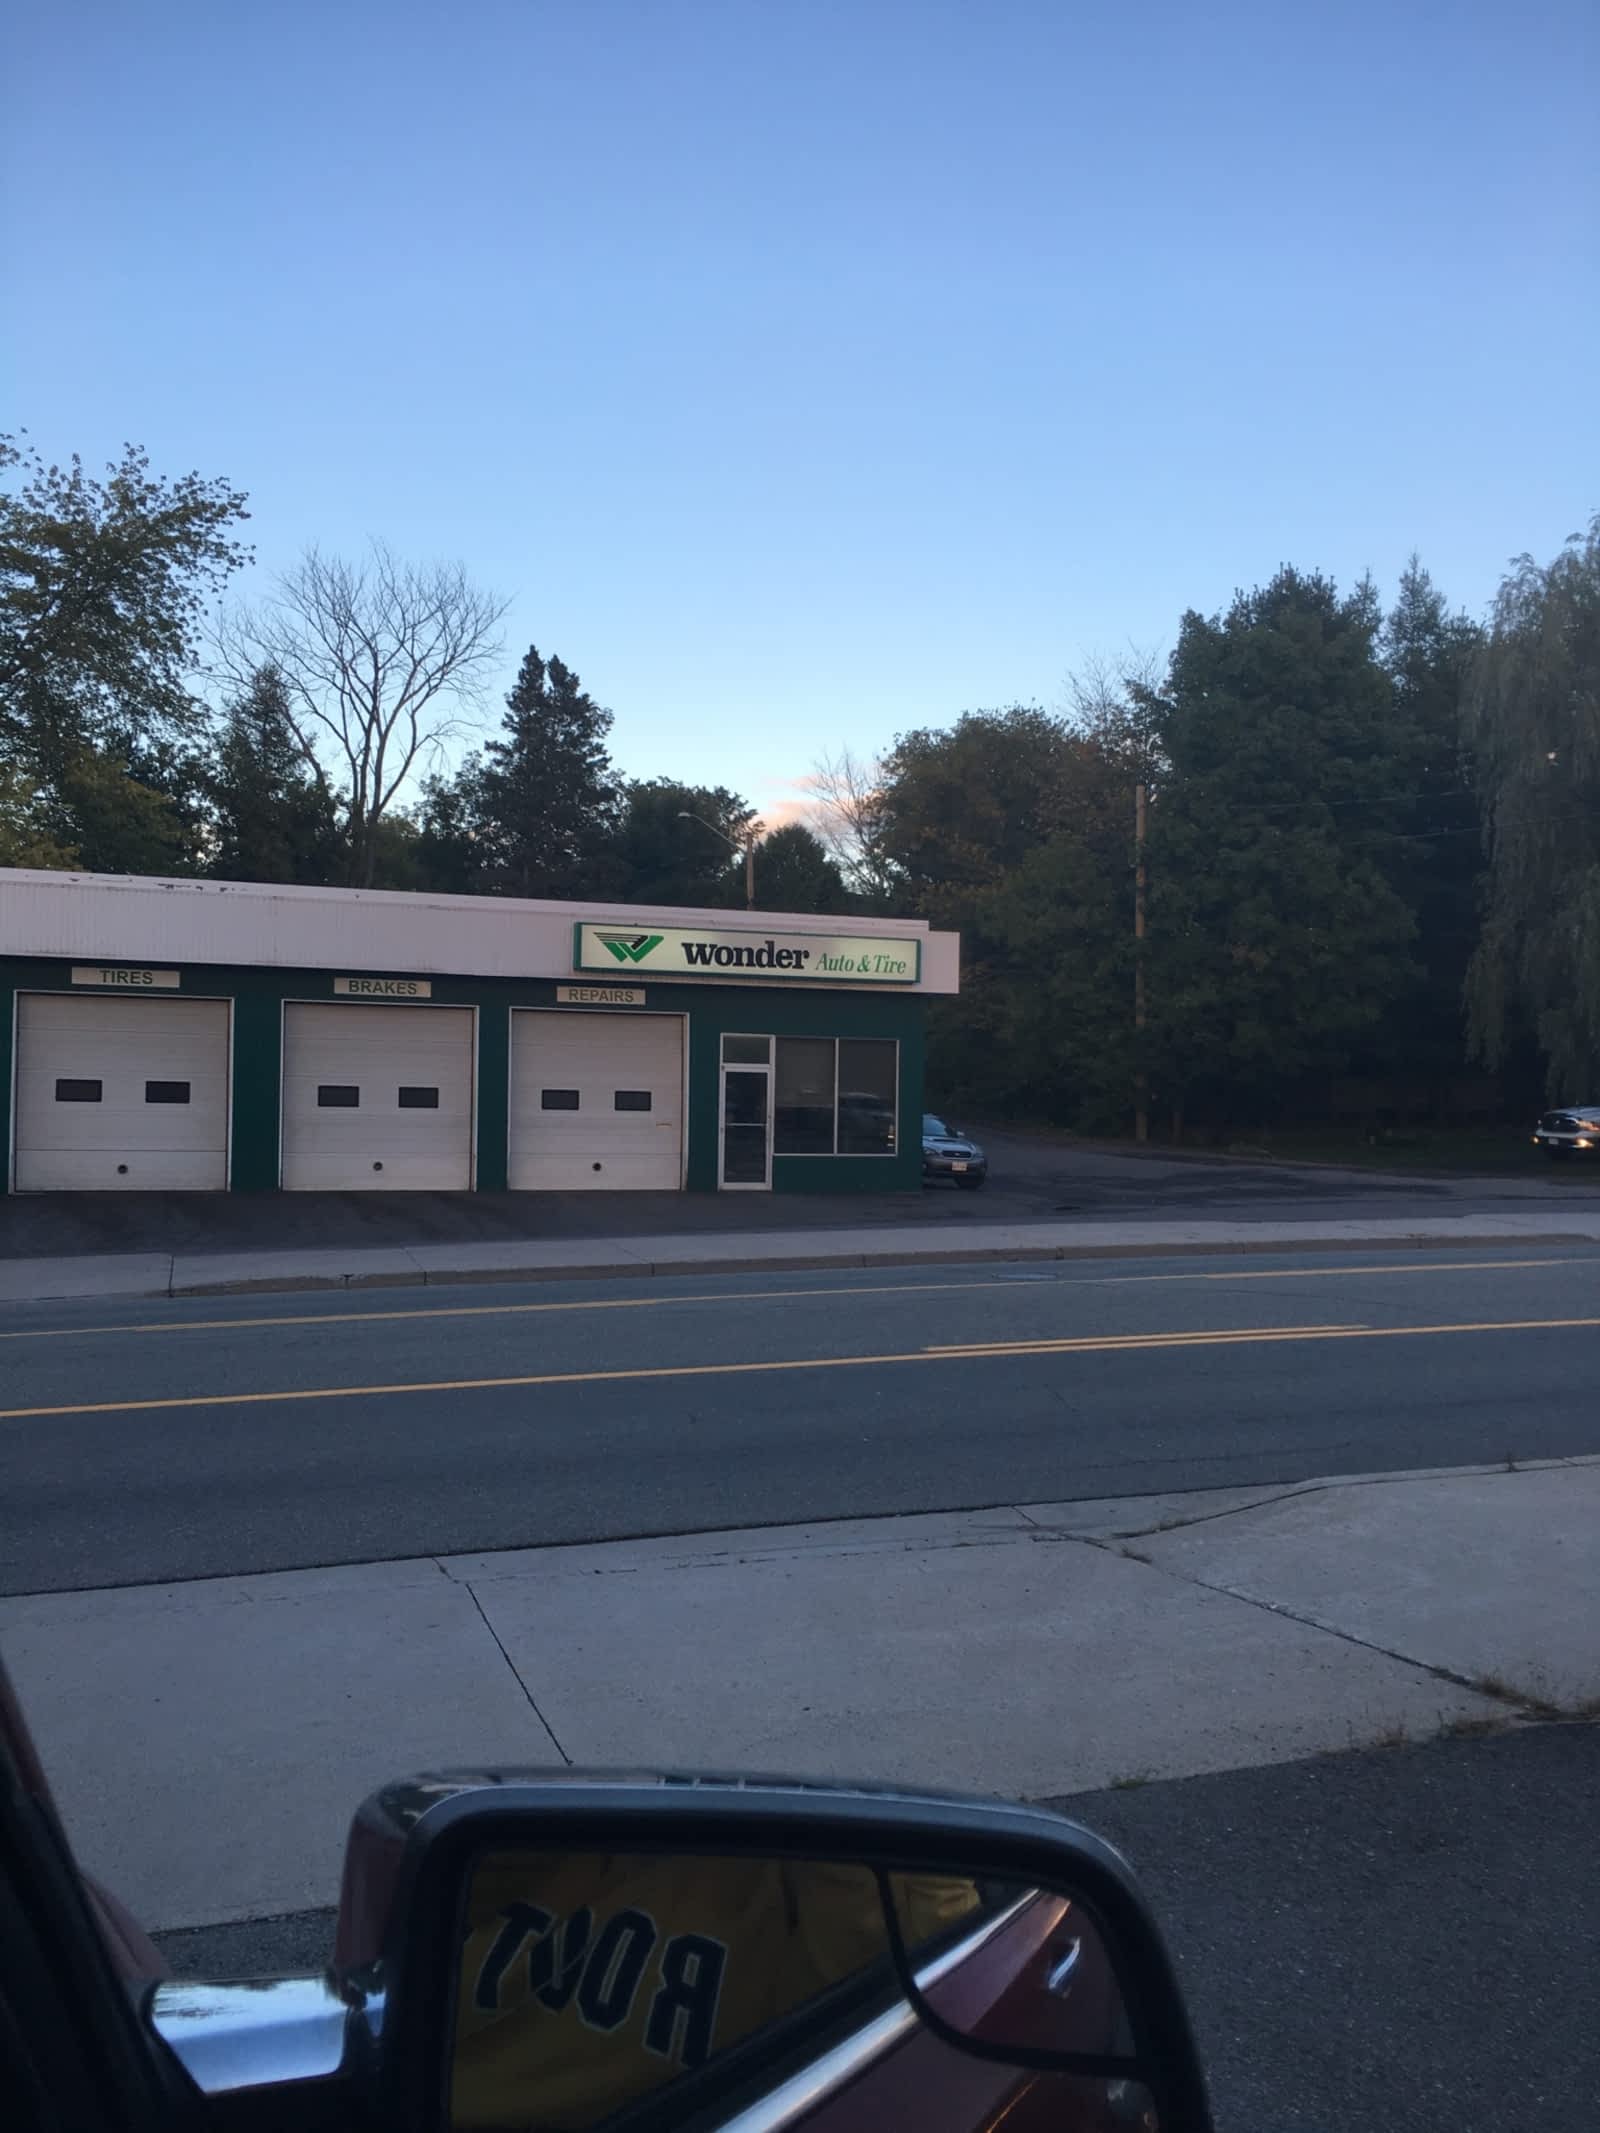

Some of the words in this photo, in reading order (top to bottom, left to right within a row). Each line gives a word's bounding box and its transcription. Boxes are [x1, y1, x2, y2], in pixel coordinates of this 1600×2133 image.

[815, 952, 855, 972] Auto
[873, 954, 906, 974] Tire
[100, 970, 153, 985] TIRES
[348, 980, 417, 995] BRAKES
[568, 988, 634, 1003] REPAIRS
